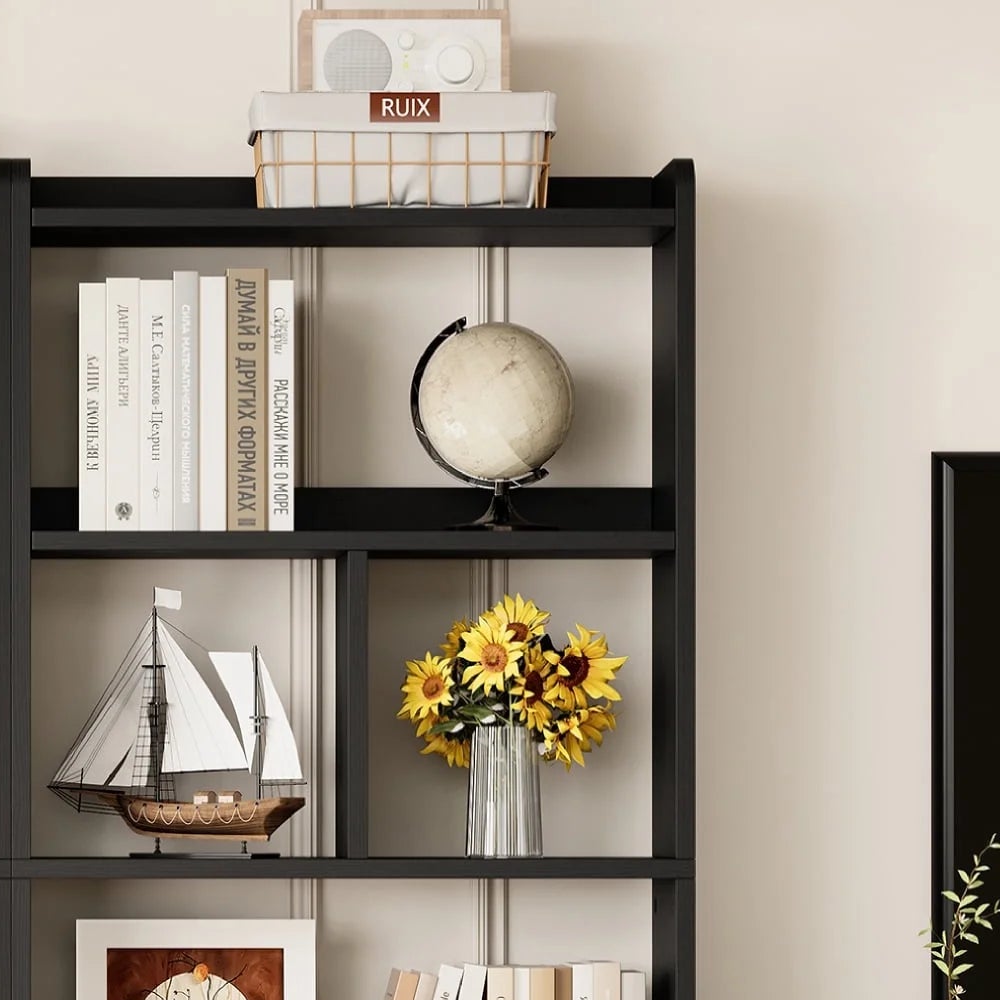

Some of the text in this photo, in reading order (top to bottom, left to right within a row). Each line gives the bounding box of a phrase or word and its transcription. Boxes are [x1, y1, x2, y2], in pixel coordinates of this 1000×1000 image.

[381, 97, 431, 117] RUIX
[180, 304, 192, 333] СИЛА
[117, 304, 130, 407] ДАНТЕ АЛИГЬЕРИ
[86, 353, 99, 472] К ВЕЧНОМУ МИРУ
[234, 279, 260, 512] ДУМАЙ В ДРУГИХ ФОРМАТАХ
[273, 378, 289, 441] РАССКАЖИ
[273, 443, 289, 469] МНЕ
[273, 482, 289, 516] МОРЕ
